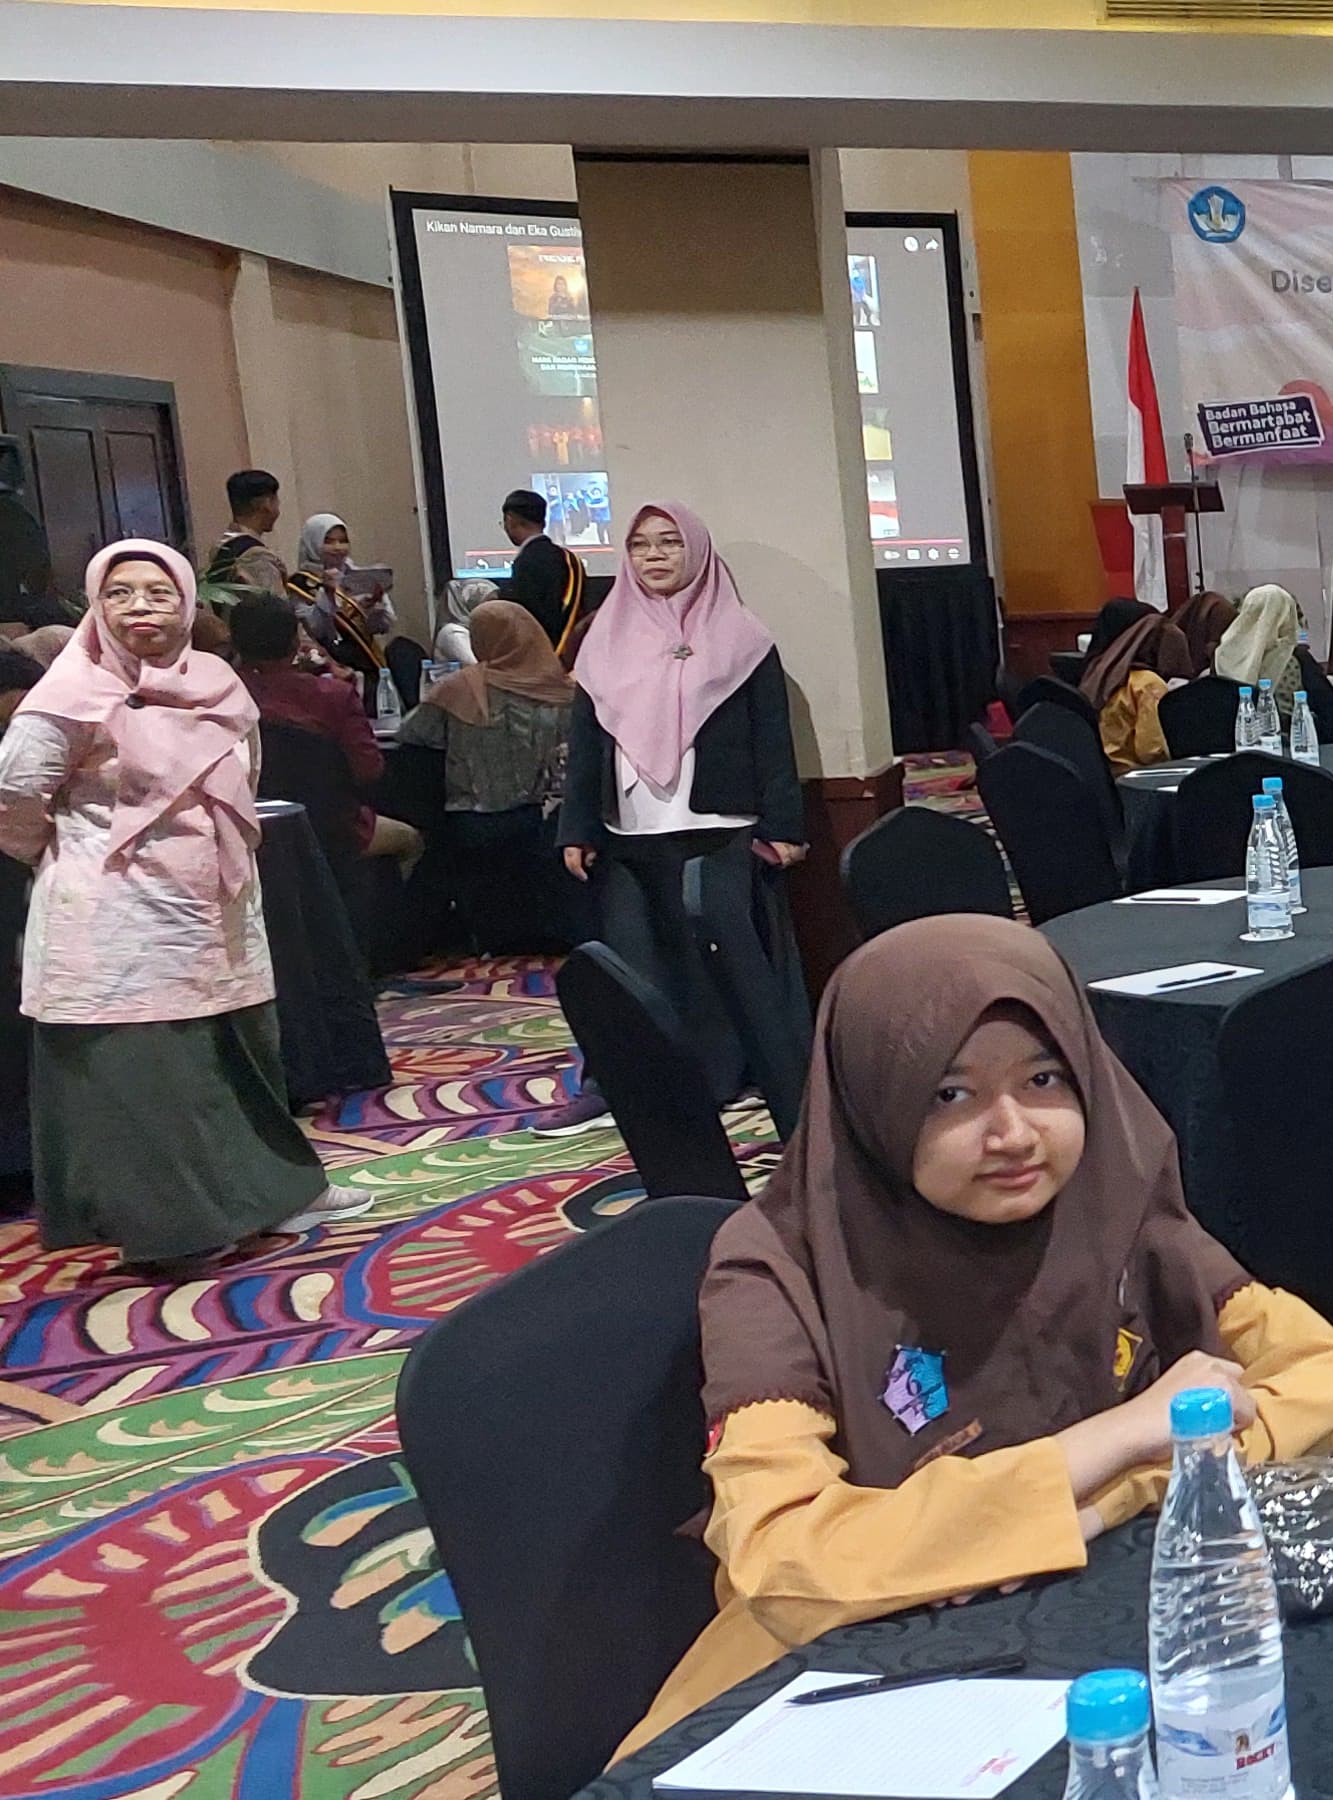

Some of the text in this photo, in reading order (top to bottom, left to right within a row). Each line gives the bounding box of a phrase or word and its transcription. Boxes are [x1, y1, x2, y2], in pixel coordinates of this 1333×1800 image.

[1205, 401, 1297, 420] Badan Bahasa
[1207, 410, 1312, 434] Bermartabat
[1211, 424, 1309, 448] Bermanfaat
